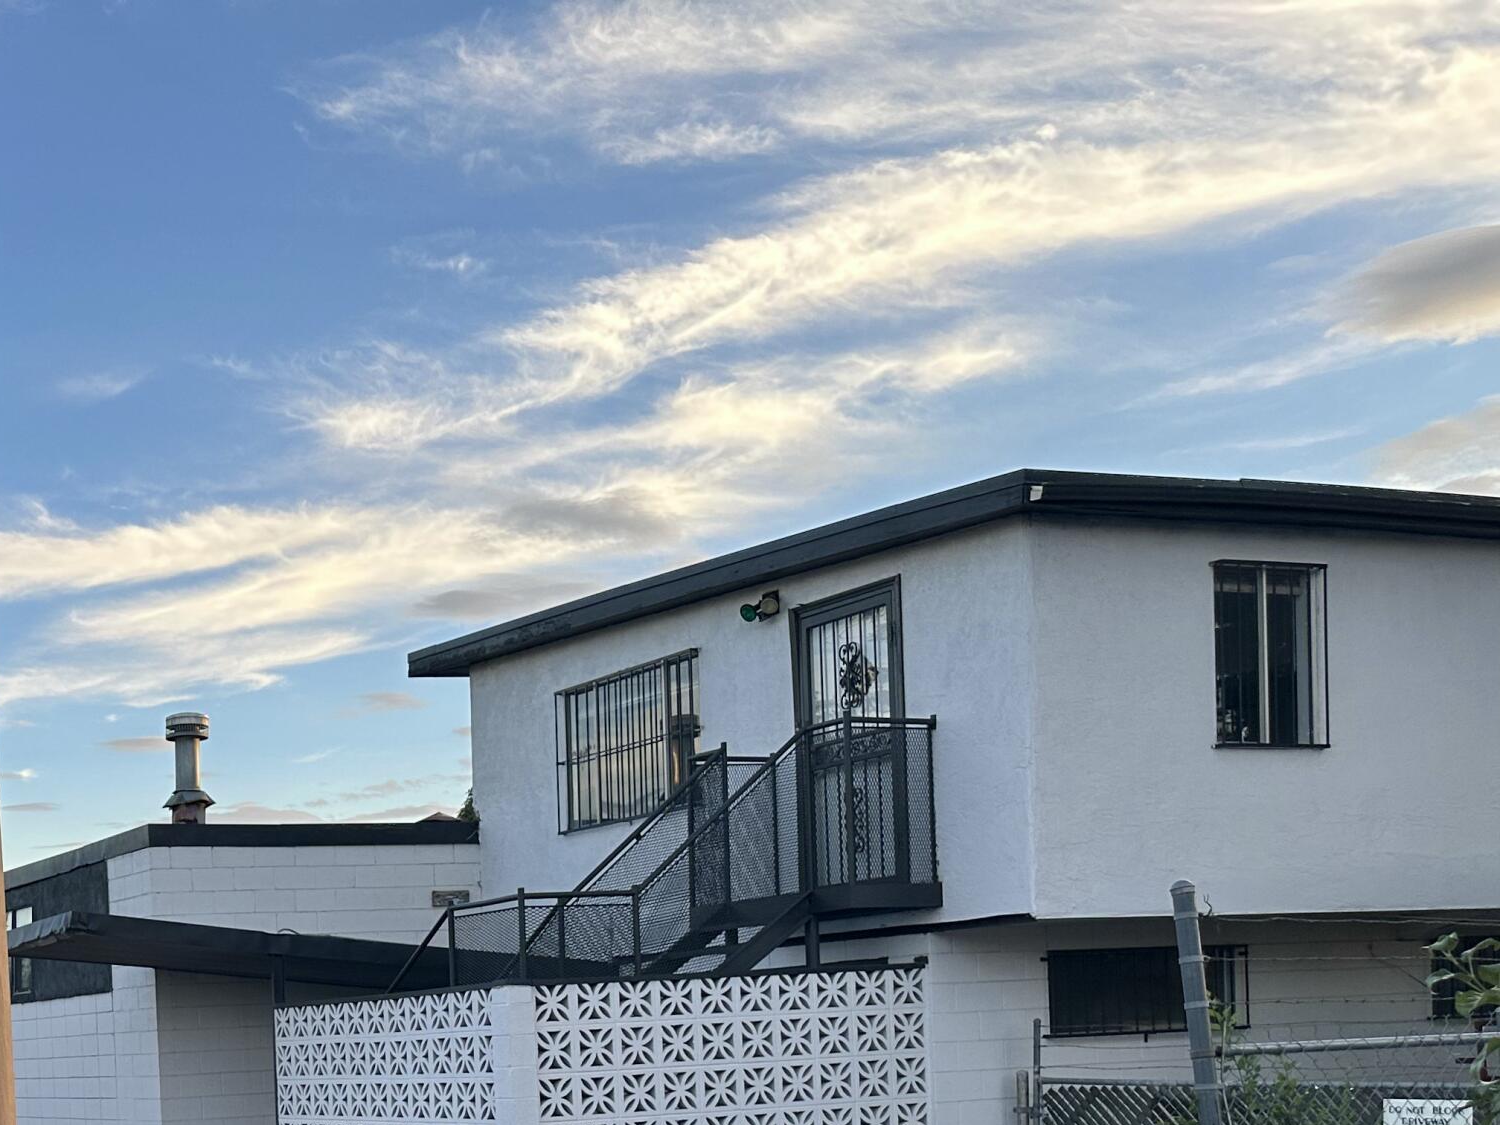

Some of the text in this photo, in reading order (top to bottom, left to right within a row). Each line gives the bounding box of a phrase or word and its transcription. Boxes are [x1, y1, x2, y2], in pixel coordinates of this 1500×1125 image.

[1388, 1105, 1402, 1114] DO
[1406, 1105, 1425, 1114] NOT
[1401, 1117, 1451, 1125] DRIVEWAY
